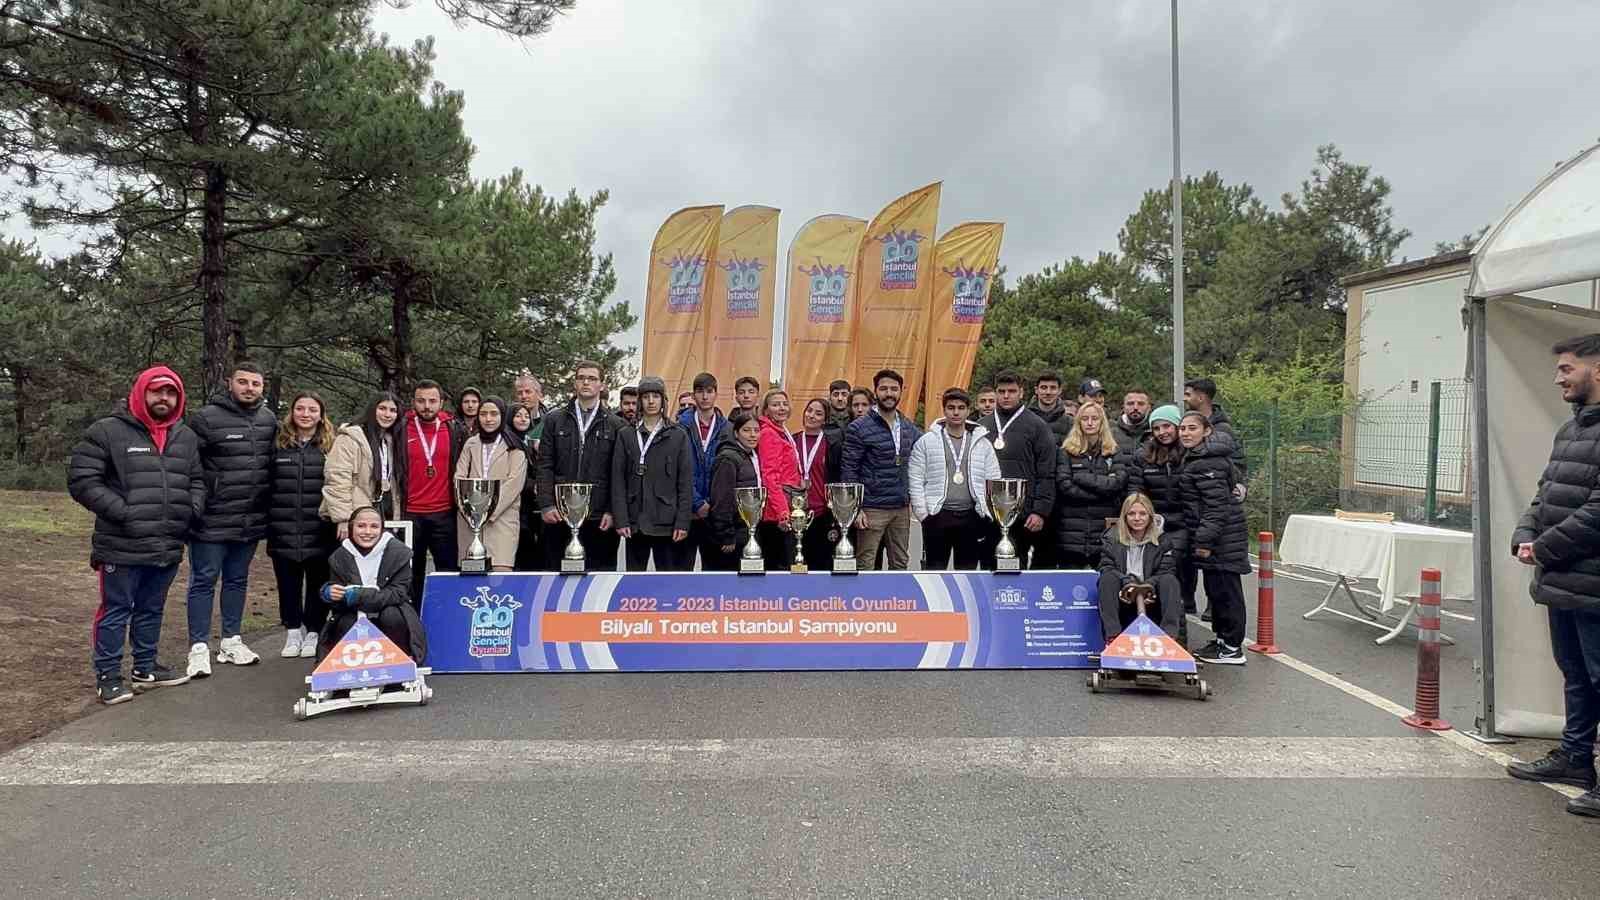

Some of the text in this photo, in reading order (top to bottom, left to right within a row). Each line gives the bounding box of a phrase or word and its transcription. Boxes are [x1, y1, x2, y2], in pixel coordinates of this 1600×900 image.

[620, 597, 657, 611] 2022
[677, 597, 715, 611] 2023
[719, 594, 783, 611] İstanbul
[788, 597, 847, 612] Gençlik
[852, 597, 917, 612] Oyunları
[600, 616, 897, 637] Bilyalı Tornet İstanbul Şampiyonu
[342, 641, 385, 666] 02
[1129, 636, 1164, 657] 10
